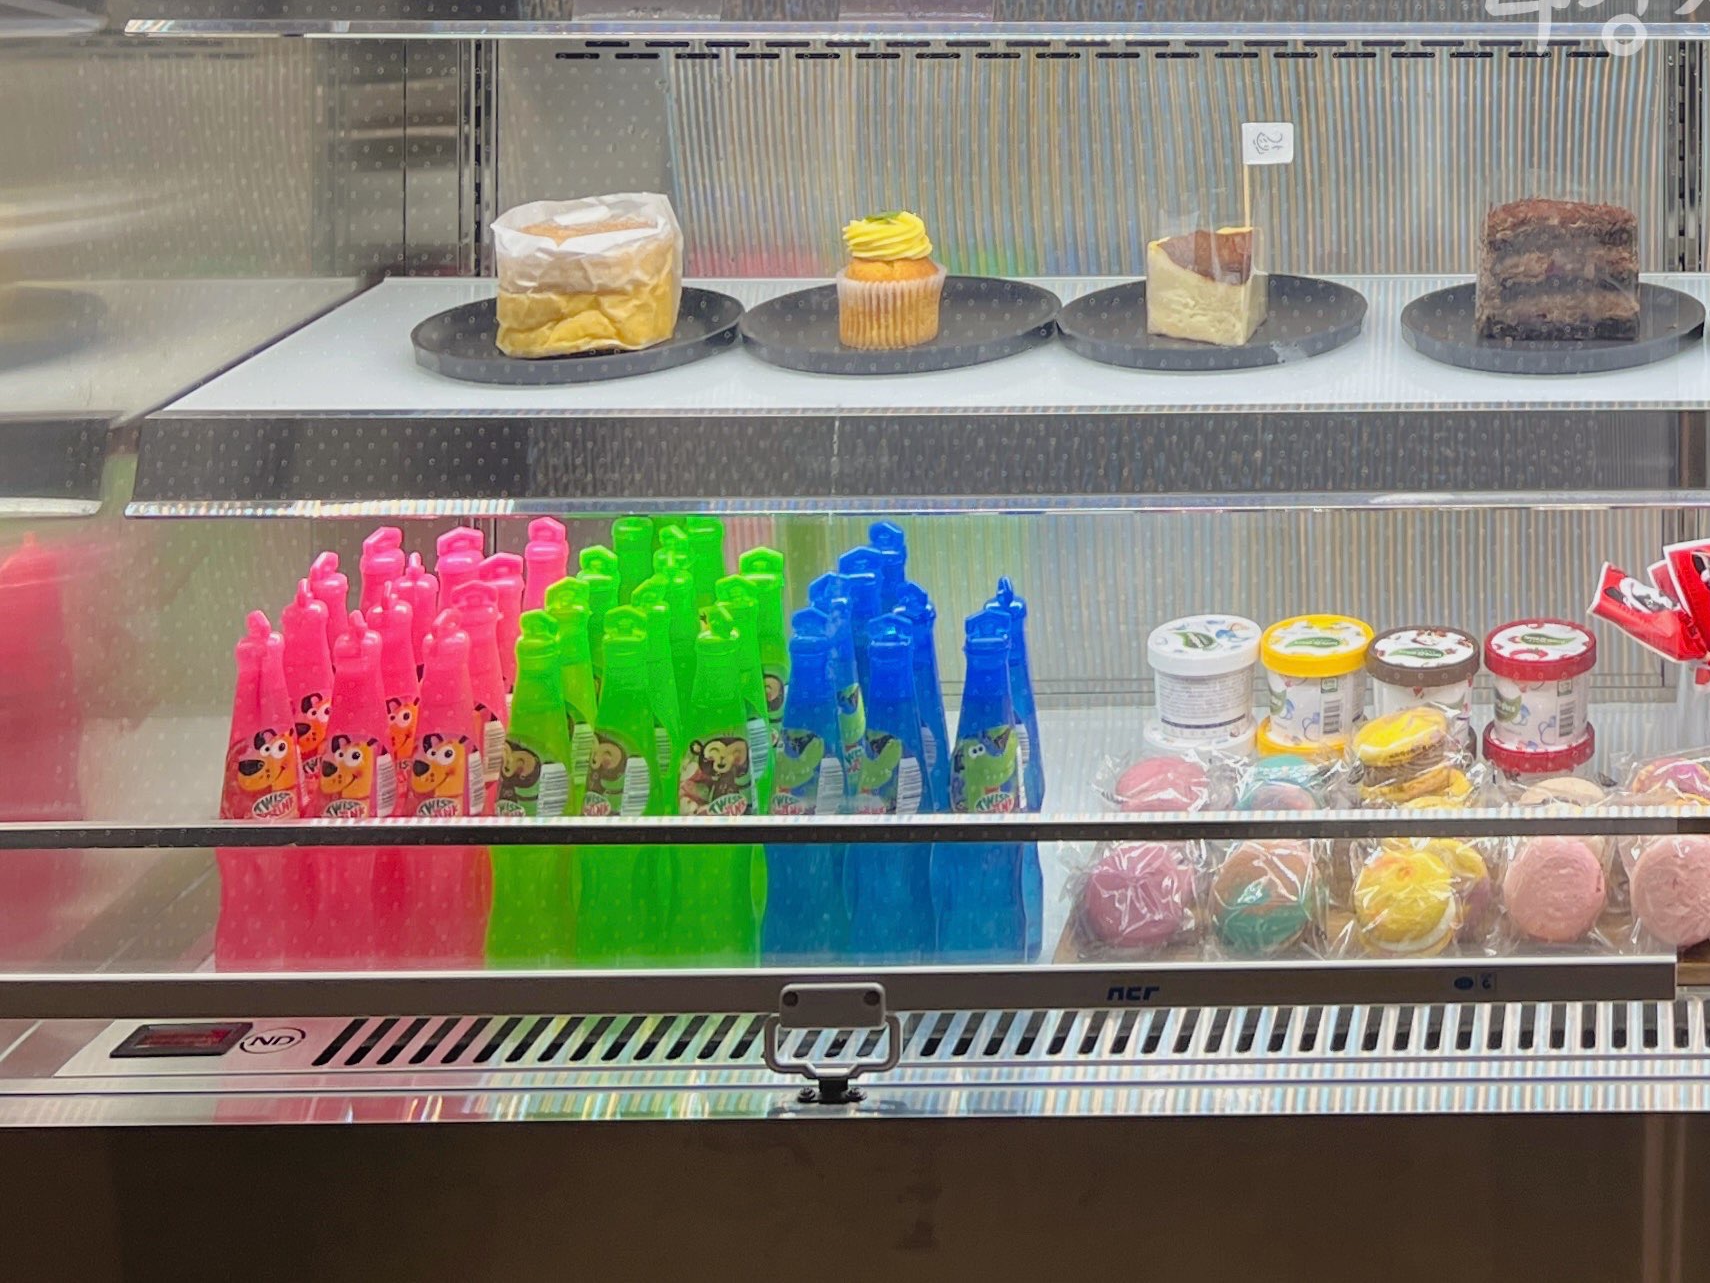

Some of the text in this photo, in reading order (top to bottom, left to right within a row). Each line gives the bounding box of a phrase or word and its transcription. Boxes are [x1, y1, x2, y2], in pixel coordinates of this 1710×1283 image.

[254, 791, 291, 813] TWIST
[418, 797, 455, 815] TWIST
[710, 794, 742, 815] TWIST
[976, 793, 1010, 812] TWIST
